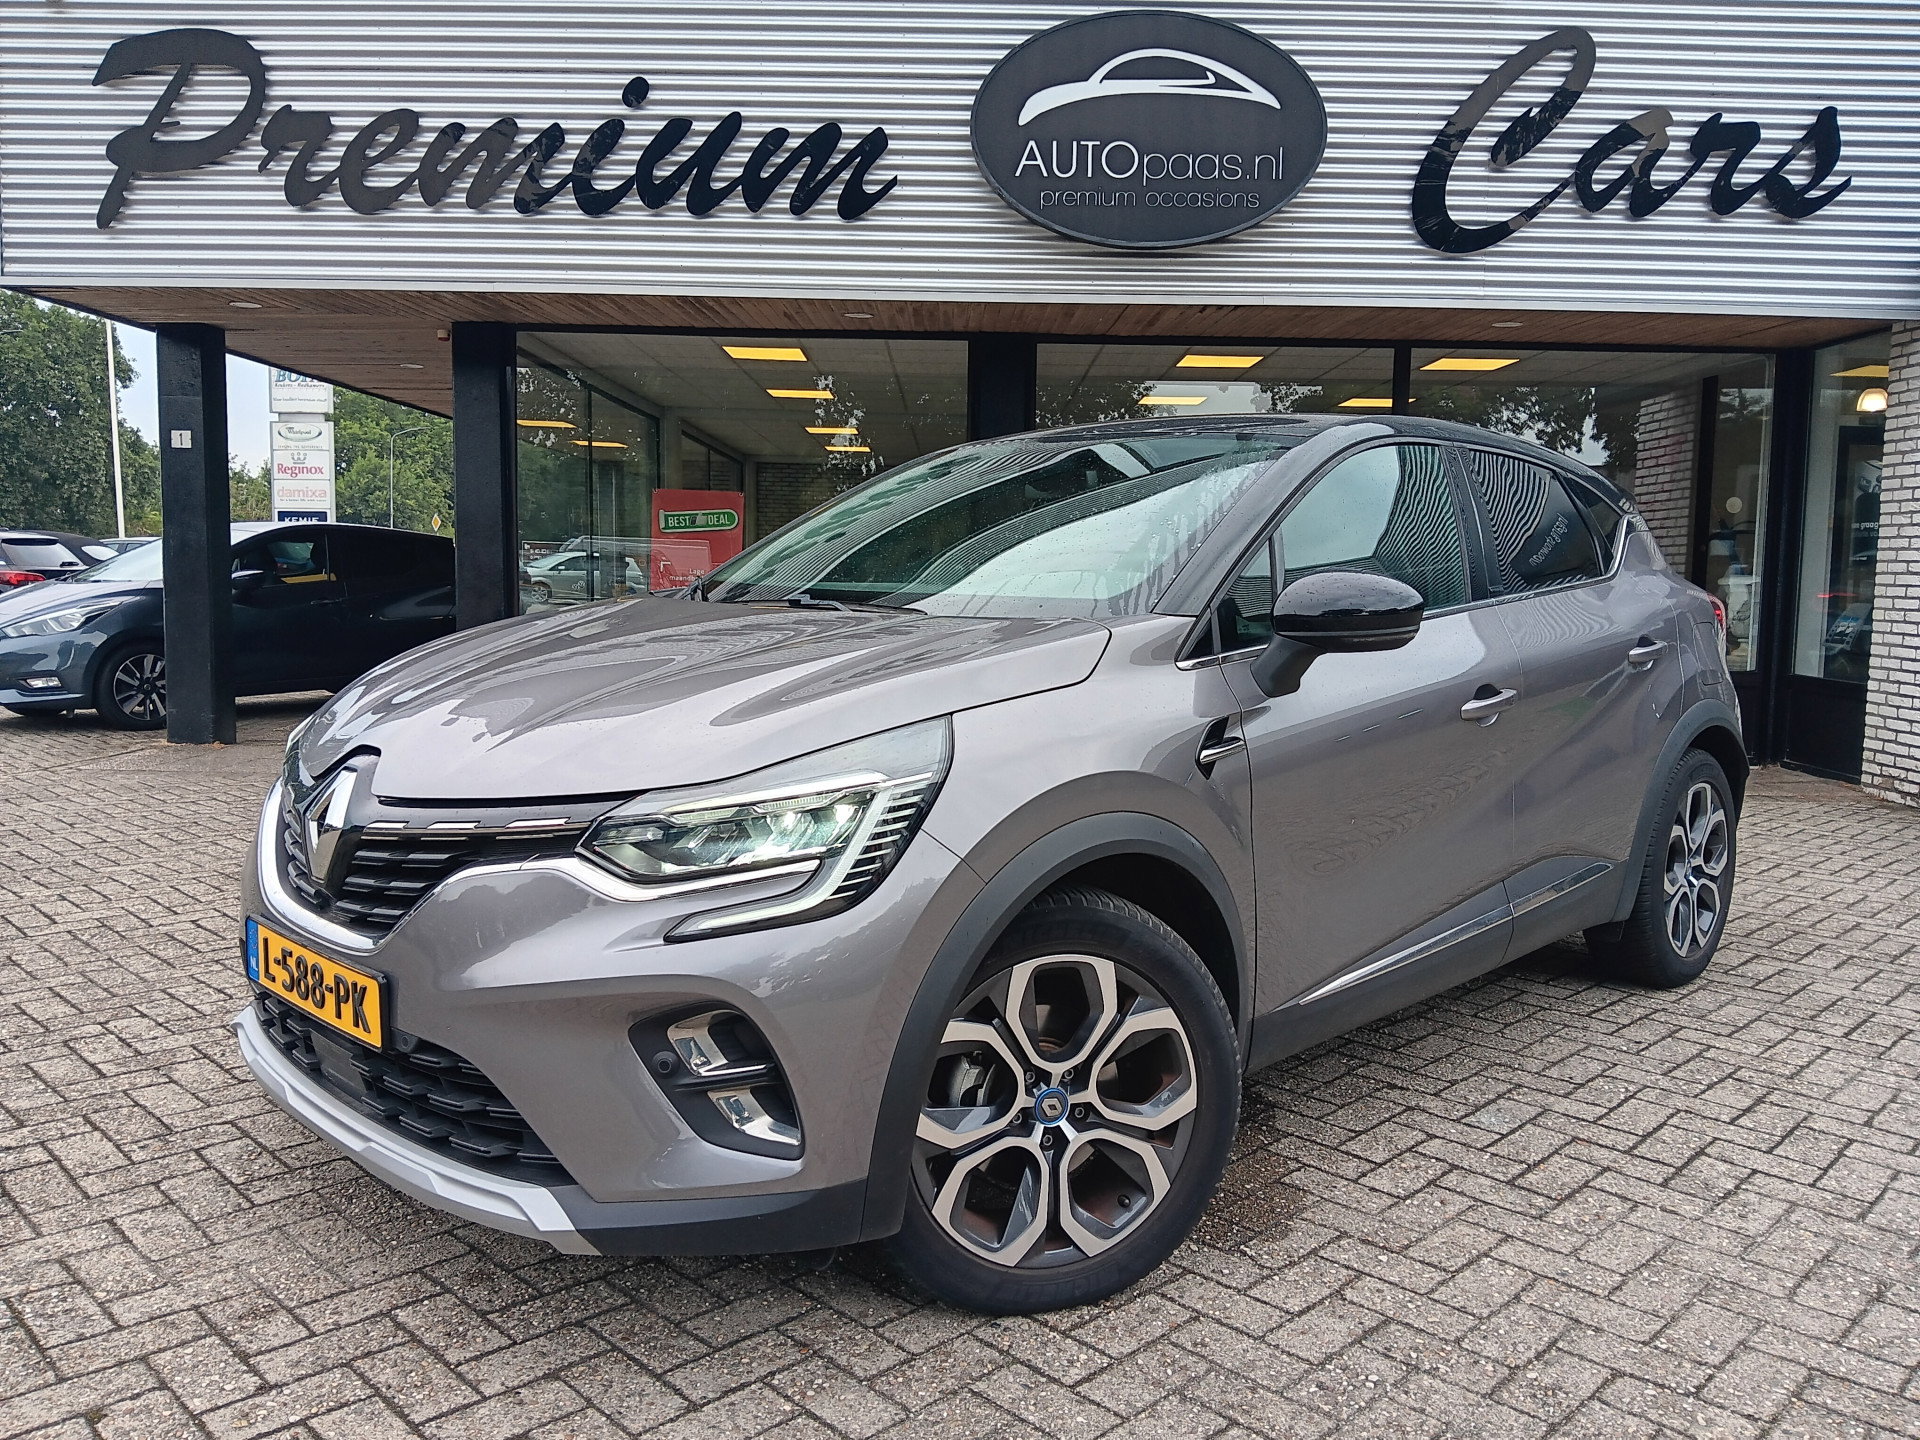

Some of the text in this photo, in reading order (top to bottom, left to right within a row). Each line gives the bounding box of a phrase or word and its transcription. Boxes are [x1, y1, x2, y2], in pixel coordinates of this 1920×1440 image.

[91, 27, 1851, 254] Premium Cars
[1014, 140, 1284, 186] AUTOpaas.nl
[1040, 186, 1260, 210] premium occasions
[179, 432, 183, 446] 1
[277, 463, 324, 478] Reginox
[277, 486, 327, 498] damixa
[668, 514, 731, 527] BEST DEAL
[690, 568, 705, 576] Lage
[250, 955, 258, 972] NL
[262, 936, 371, 1034] L-588-PK
